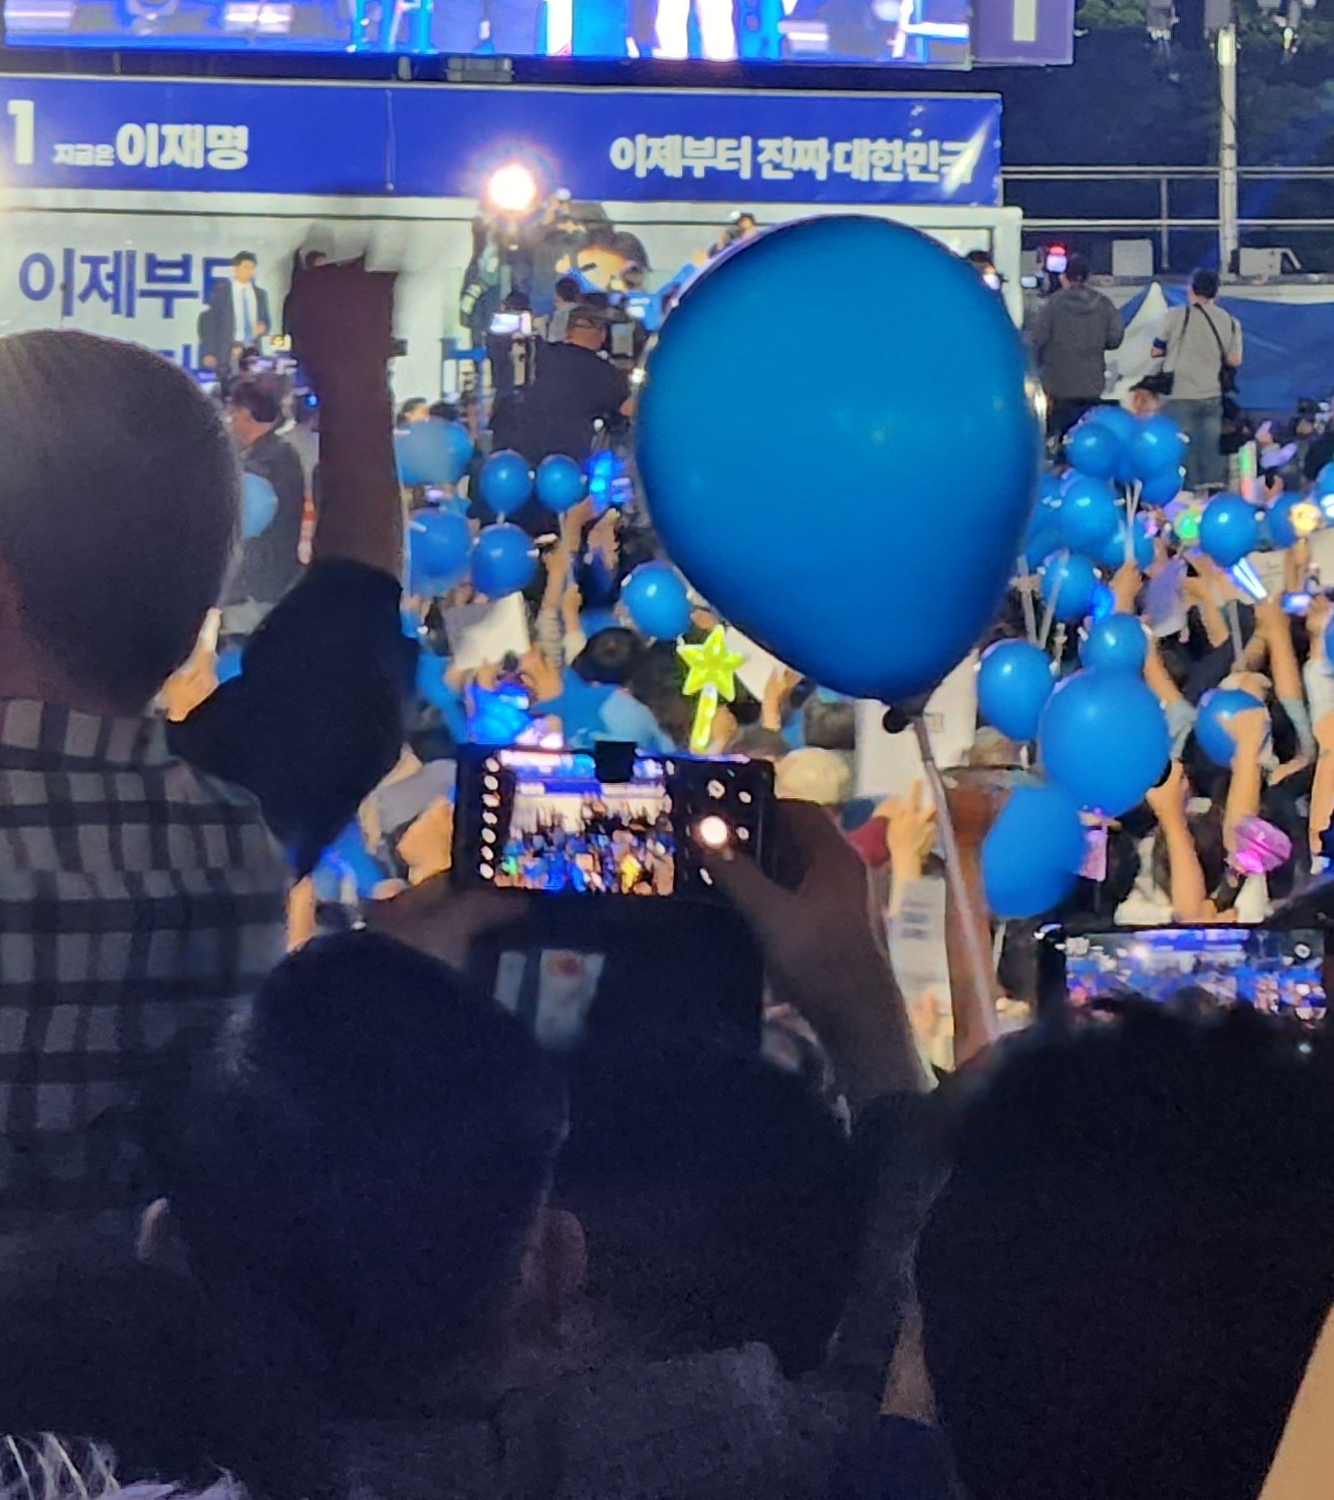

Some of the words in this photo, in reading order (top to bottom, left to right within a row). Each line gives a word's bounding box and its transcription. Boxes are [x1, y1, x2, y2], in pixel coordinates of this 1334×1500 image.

[7, 99, 34, 165] 1
[117, 122, 249, 171] 이재명
[609, 133, 753, 180] 이제부터
[757, 136, 831, 181] 진짜
